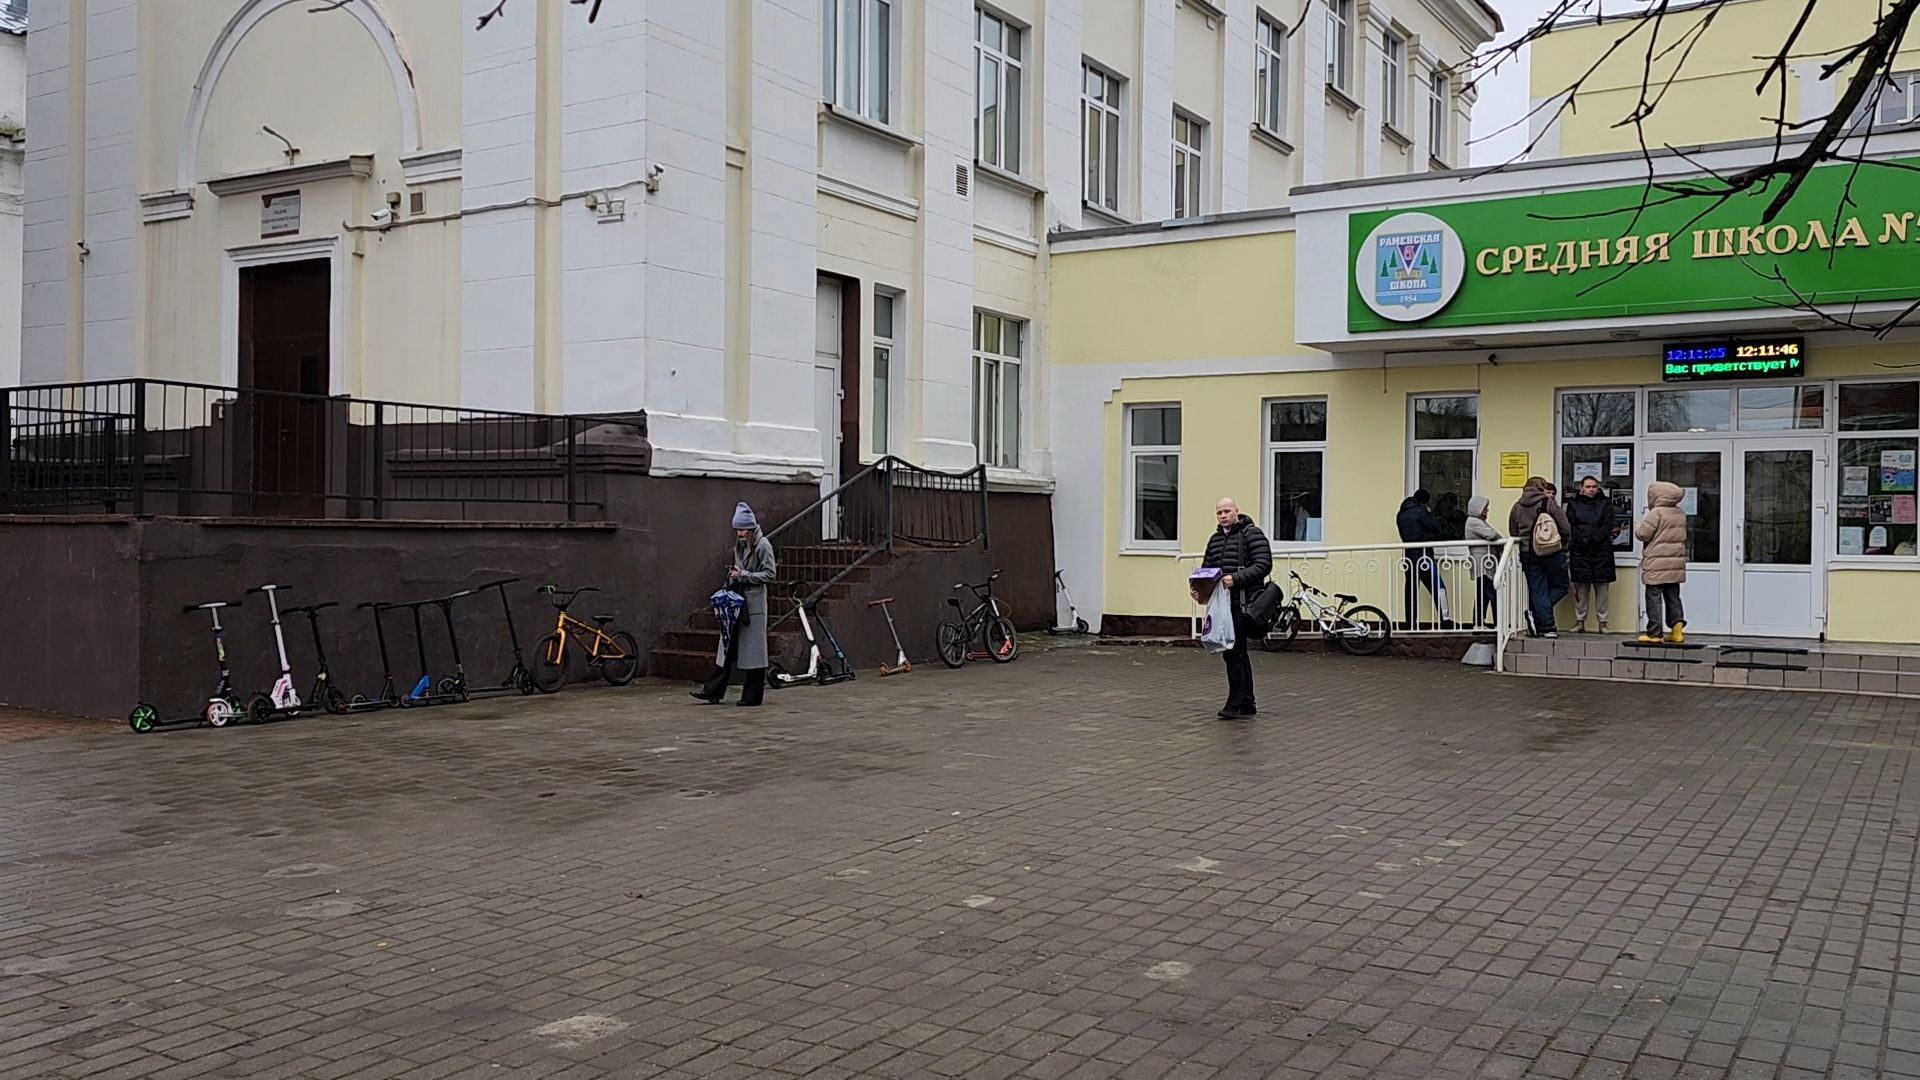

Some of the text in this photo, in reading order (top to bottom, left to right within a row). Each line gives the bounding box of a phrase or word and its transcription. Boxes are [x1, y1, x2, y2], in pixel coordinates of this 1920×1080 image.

[1379, 233, 1440, 247] РАМЕНСКАЯ
[1476, 232, 1670, 276] СРЕДНЯЯ
[1692, 216, 1870, 258] ШКОЛА
[1389, 280, 1427, 290] ШКОЛА
[1400, 295, 1417, 303] 1954
[1667, 344, 1798, 360] 12:11:25 12:11:46
[1665, 364, 1689, 374] Вас
[1692, 361, 1786, 375] приветствует
